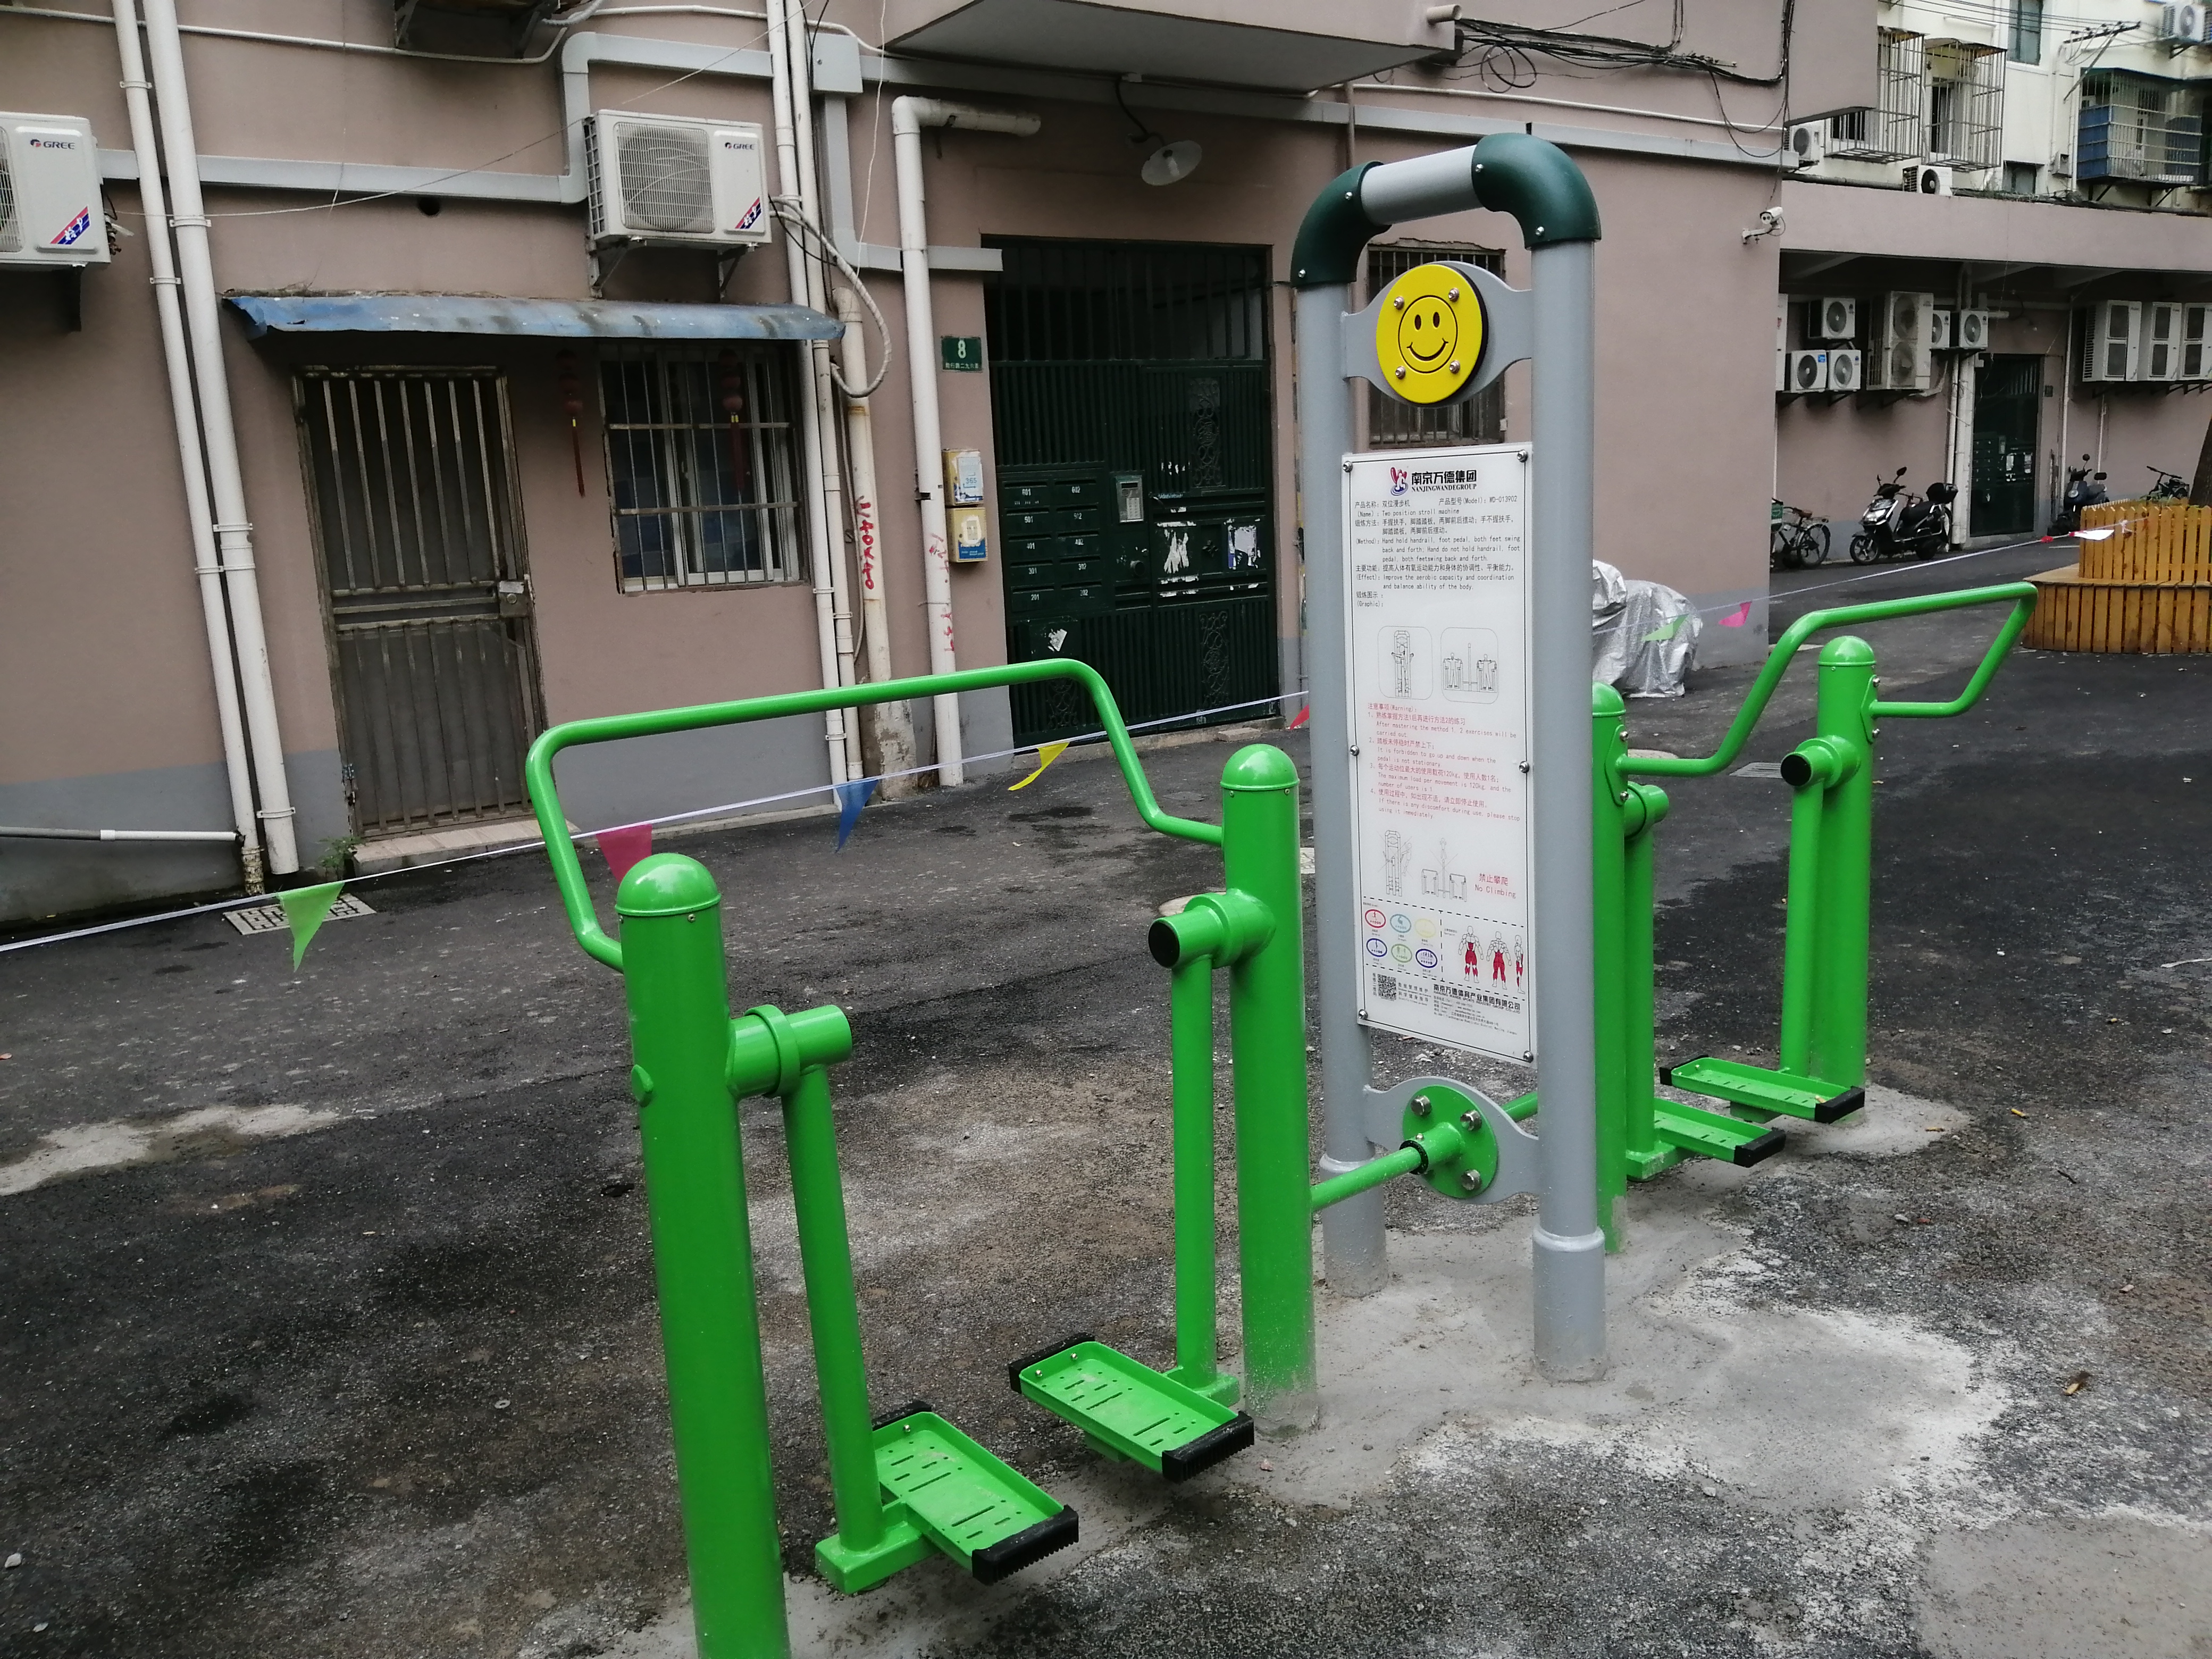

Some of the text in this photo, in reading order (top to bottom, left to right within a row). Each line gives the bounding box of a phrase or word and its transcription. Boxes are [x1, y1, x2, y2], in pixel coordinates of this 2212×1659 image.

[43, 141, 75, 149] GREE
[958, 340, 966, 358] 8
[1412, 470, 1477, 485] 南京万德集团
[1412, 484, 1477, 492] NANJINGWANDEGROUP
[1452, 806, 1470, 815] during
[1479, 873, 1508, 886] 禁止攀爬
[1486, 885, 1516, 899] Climbing
